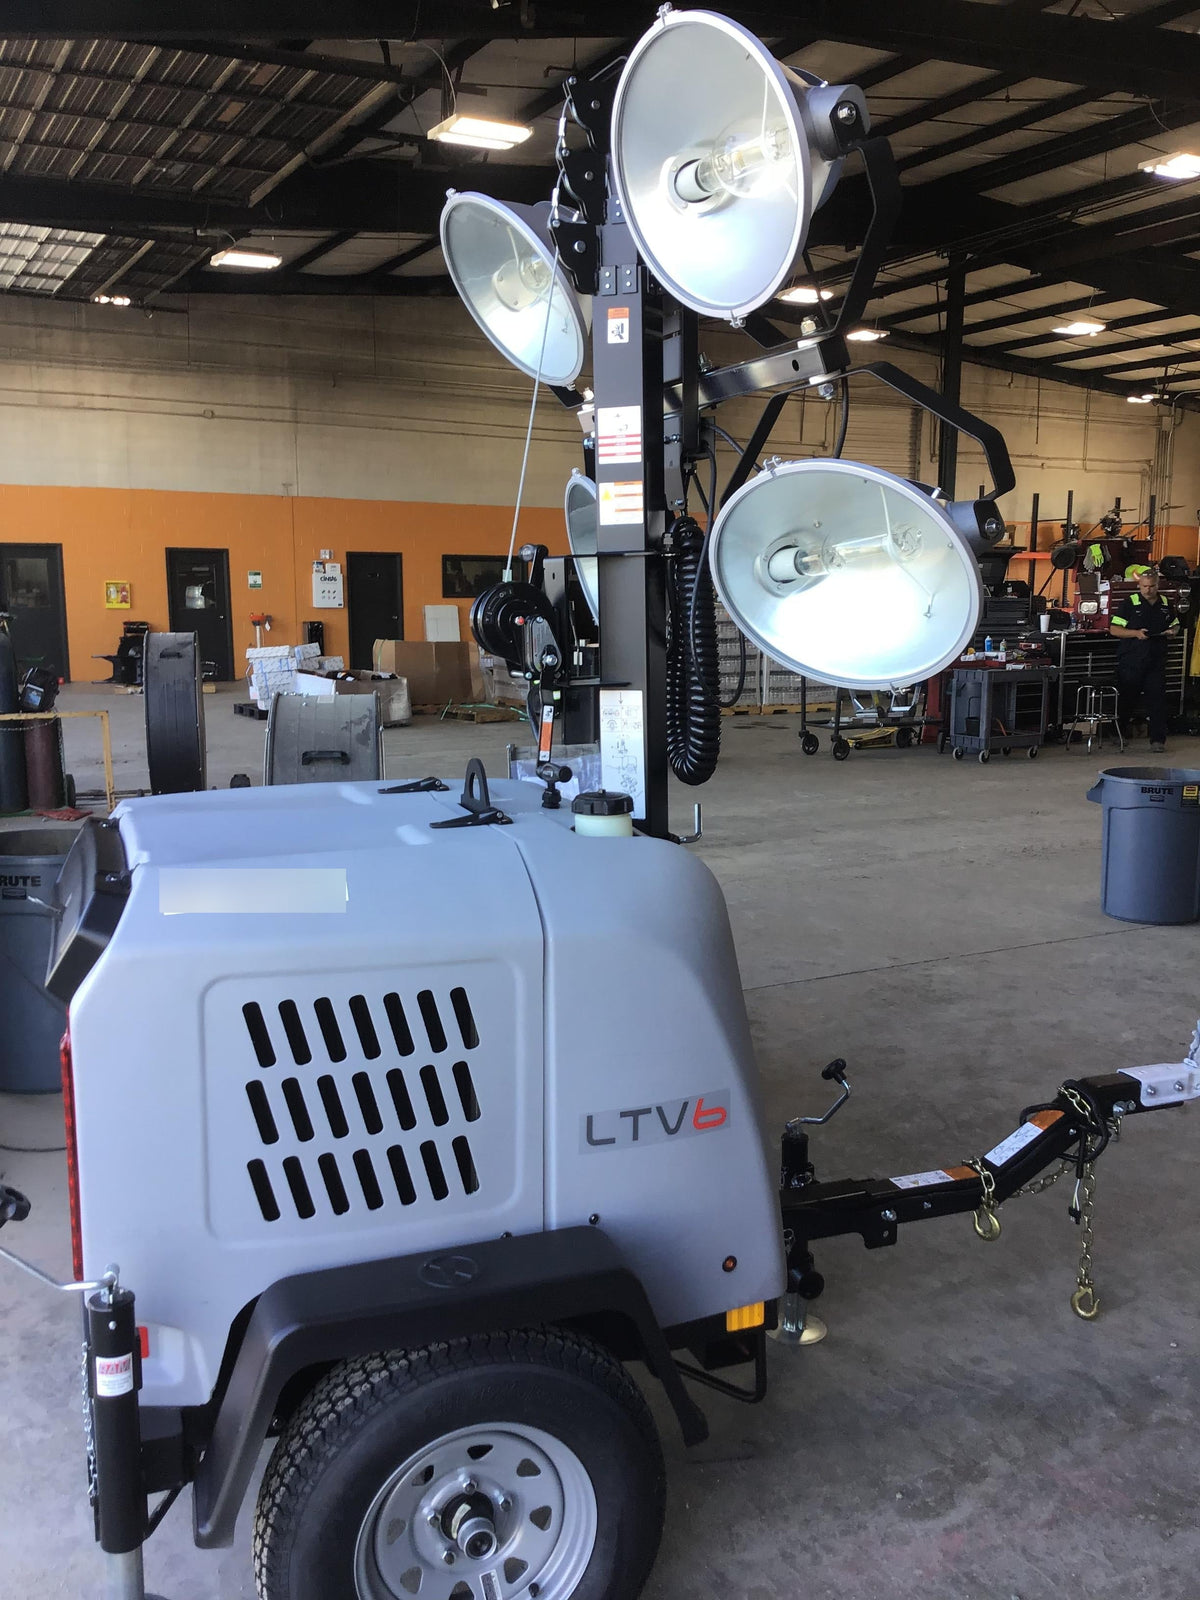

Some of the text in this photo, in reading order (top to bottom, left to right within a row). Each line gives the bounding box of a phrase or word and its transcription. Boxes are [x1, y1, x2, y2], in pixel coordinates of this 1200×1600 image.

[1141, 786, 1174, 794] BRUTE
[0, 875, 41, 887] RUTE
[586, 1098, 727, 1146] LTV6
